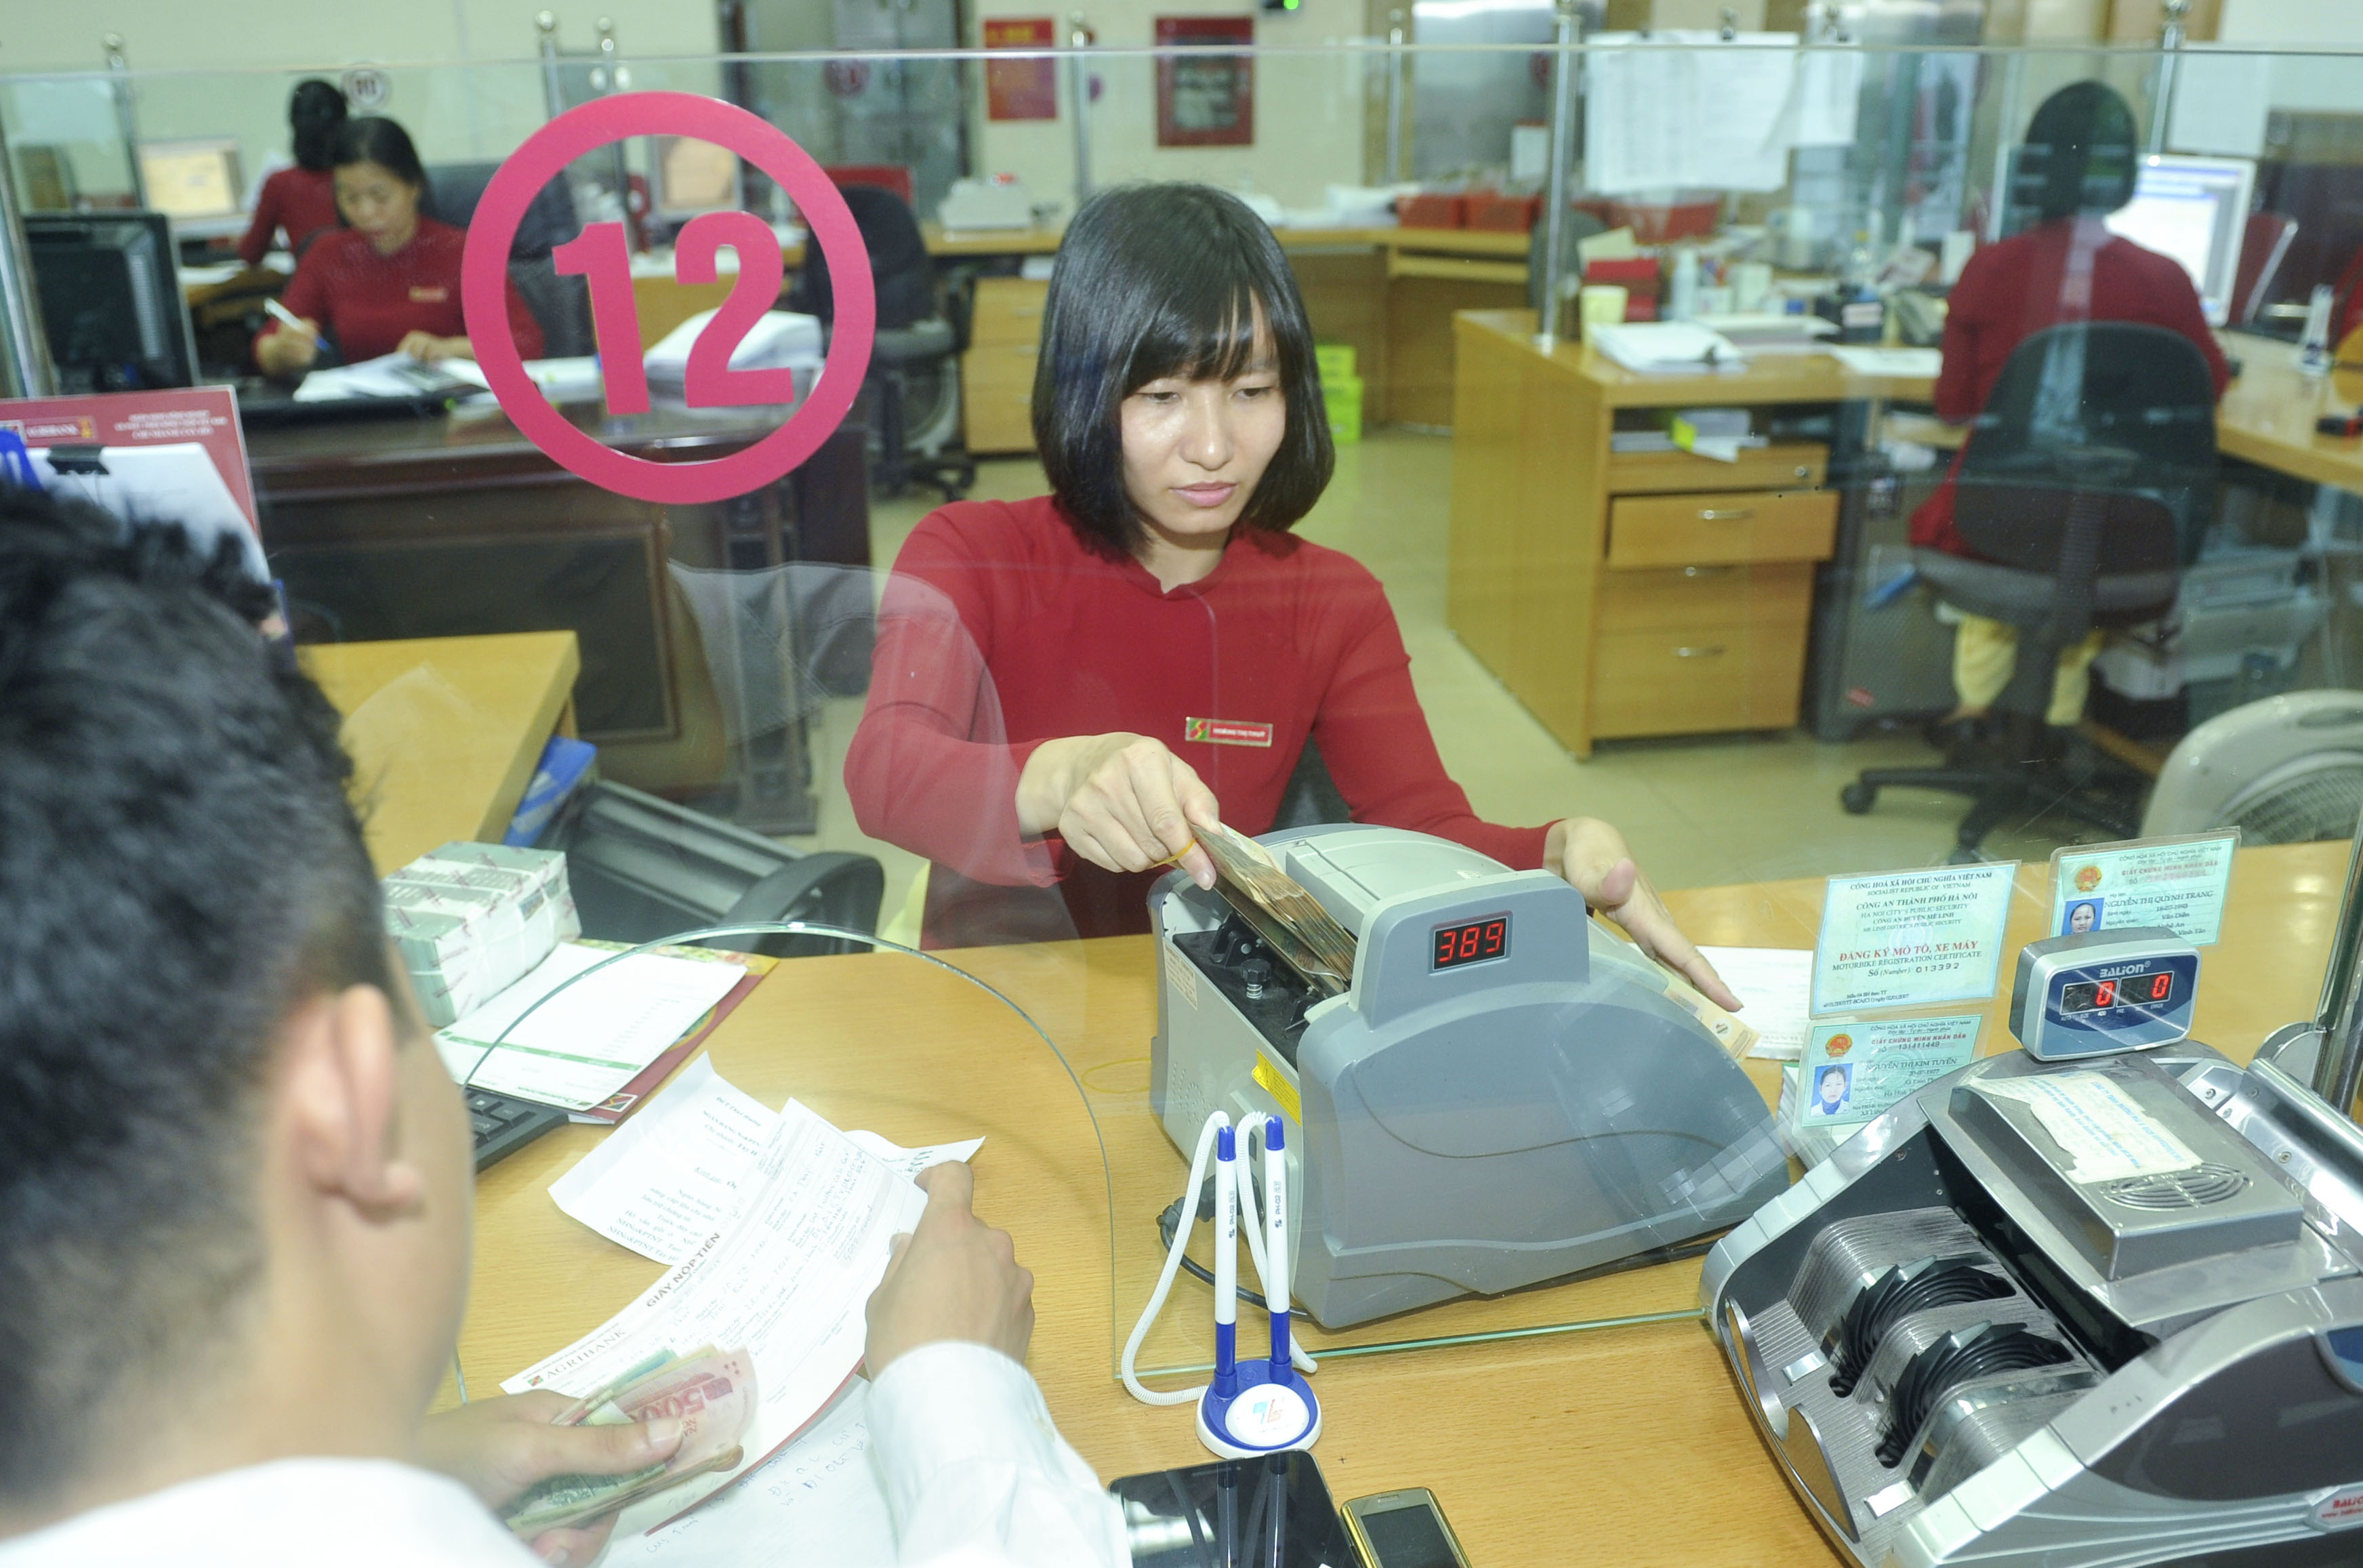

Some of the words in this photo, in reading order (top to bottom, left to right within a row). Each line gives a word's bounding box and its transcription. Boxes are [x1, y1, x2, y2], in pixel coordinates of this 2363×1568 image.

[552, 211, 794, 415] 12
[1850, 881, 1870, 892] CỘNG
[1933, 873, 1957, 883] NGHĨA
[1857, 900, 1881, 910] CÔNG
[1897, 896, 1926, 907] THÀNH
[1929, 894, 1946, 904] PHỐ
[1948, 893, 1960, 902] HÀ
[1963, 891, 1977, 903] NỘI
[2186, 890, 2213, 900] TRANG
[1936, 903, 1969, 911] SECURITY
[1439, 922, 1504, 962] 389
[1839, 949, 1870, 962] ĐĂNG
[1874, 947, 1890, 958] KÝ
[1892, 945, 1912, 957] MÔ
[1935, 944, 1950, 953] XE
[1952, 939, 1978, 951] MÁY
[1832, 961, 1876, 971] MOTORBIKE
[1878, 955, 1932, 966] REGISTRATION
[1933, 951, 1981, 961] CERTIFICATE
[1915, 962, 1960, 974] 013392
[2096, 981, 2114, 1006] 0
[2152, 974, 2170, 998] 0
[646, 1282, 673, 1308] GIẤY
[672, 1258, 697, 1283] NỘP
[695, 1232, 721, 1258] TIỀN
[546, 1328, 626, 1380] AGRIBANK
